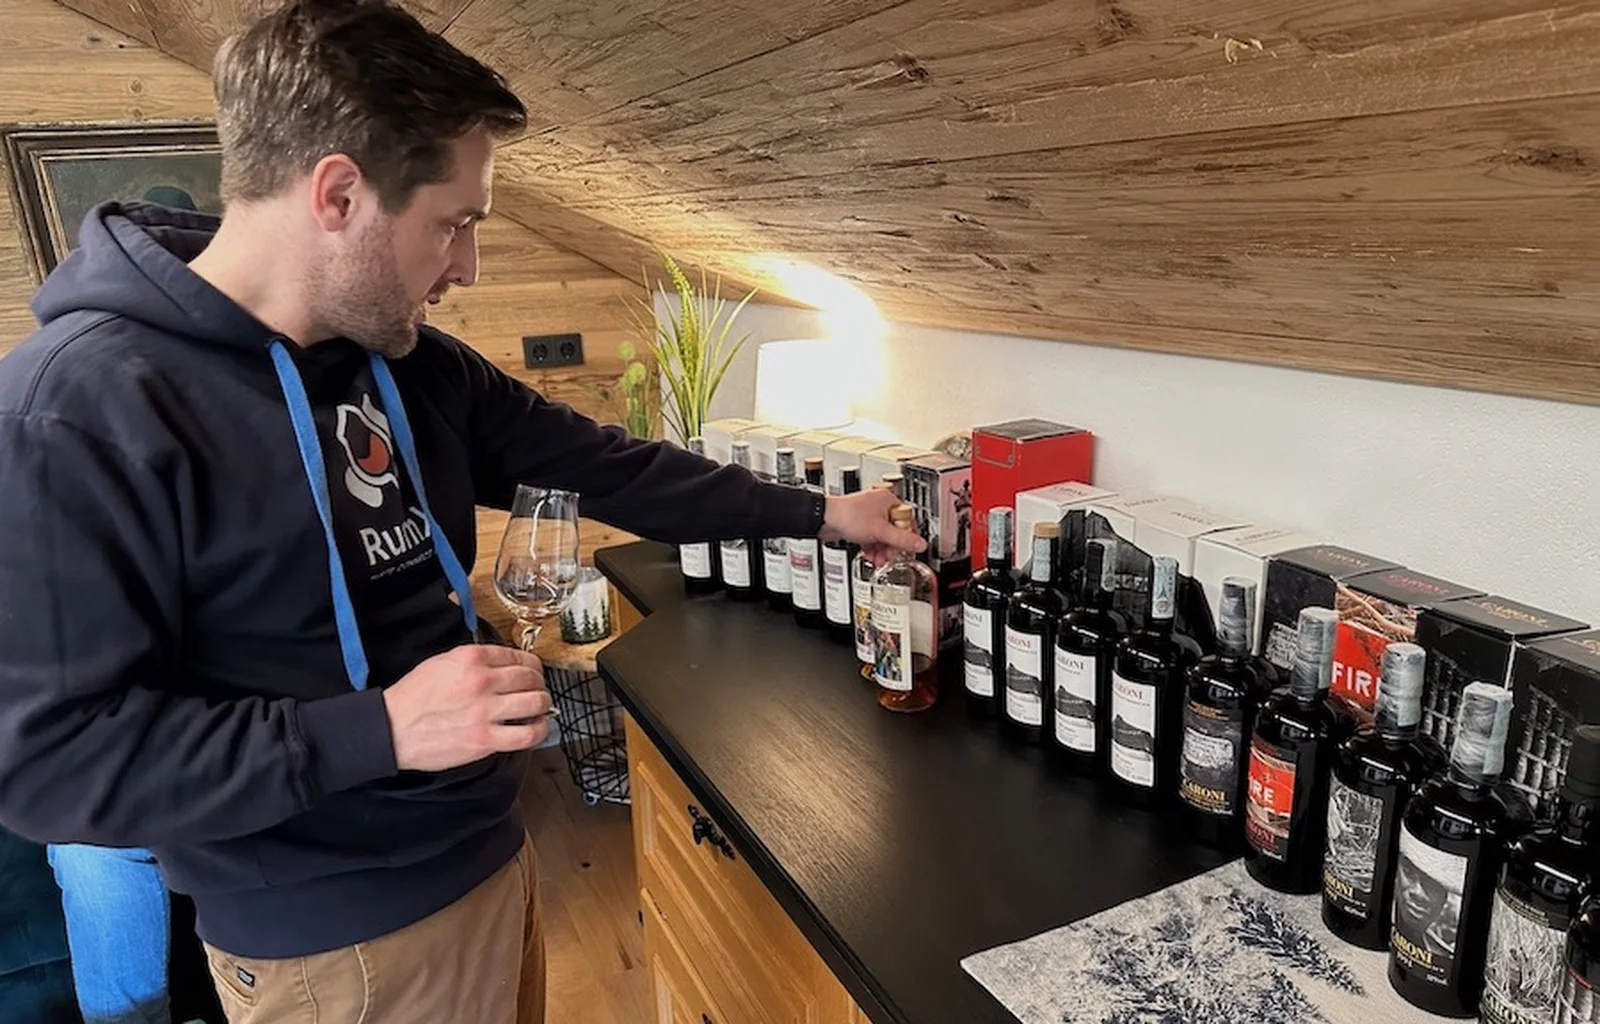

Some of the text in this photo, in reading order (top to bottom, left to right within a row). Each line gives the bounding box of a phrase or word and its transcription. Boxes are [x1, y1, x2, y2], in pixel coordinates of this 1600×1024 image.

[872, 602, 897, 615] ARONI
[1006, 634, 1032, 649] ARONI
[1057, 655, 1084, 670] ARONI
[1332, 660, 1381, 700] FIR
[1114, 681, 1143, 700] ARONI
[1182, 778, 1225, 801] CARONI
[1323, 869, 1354, 898] ARONI
